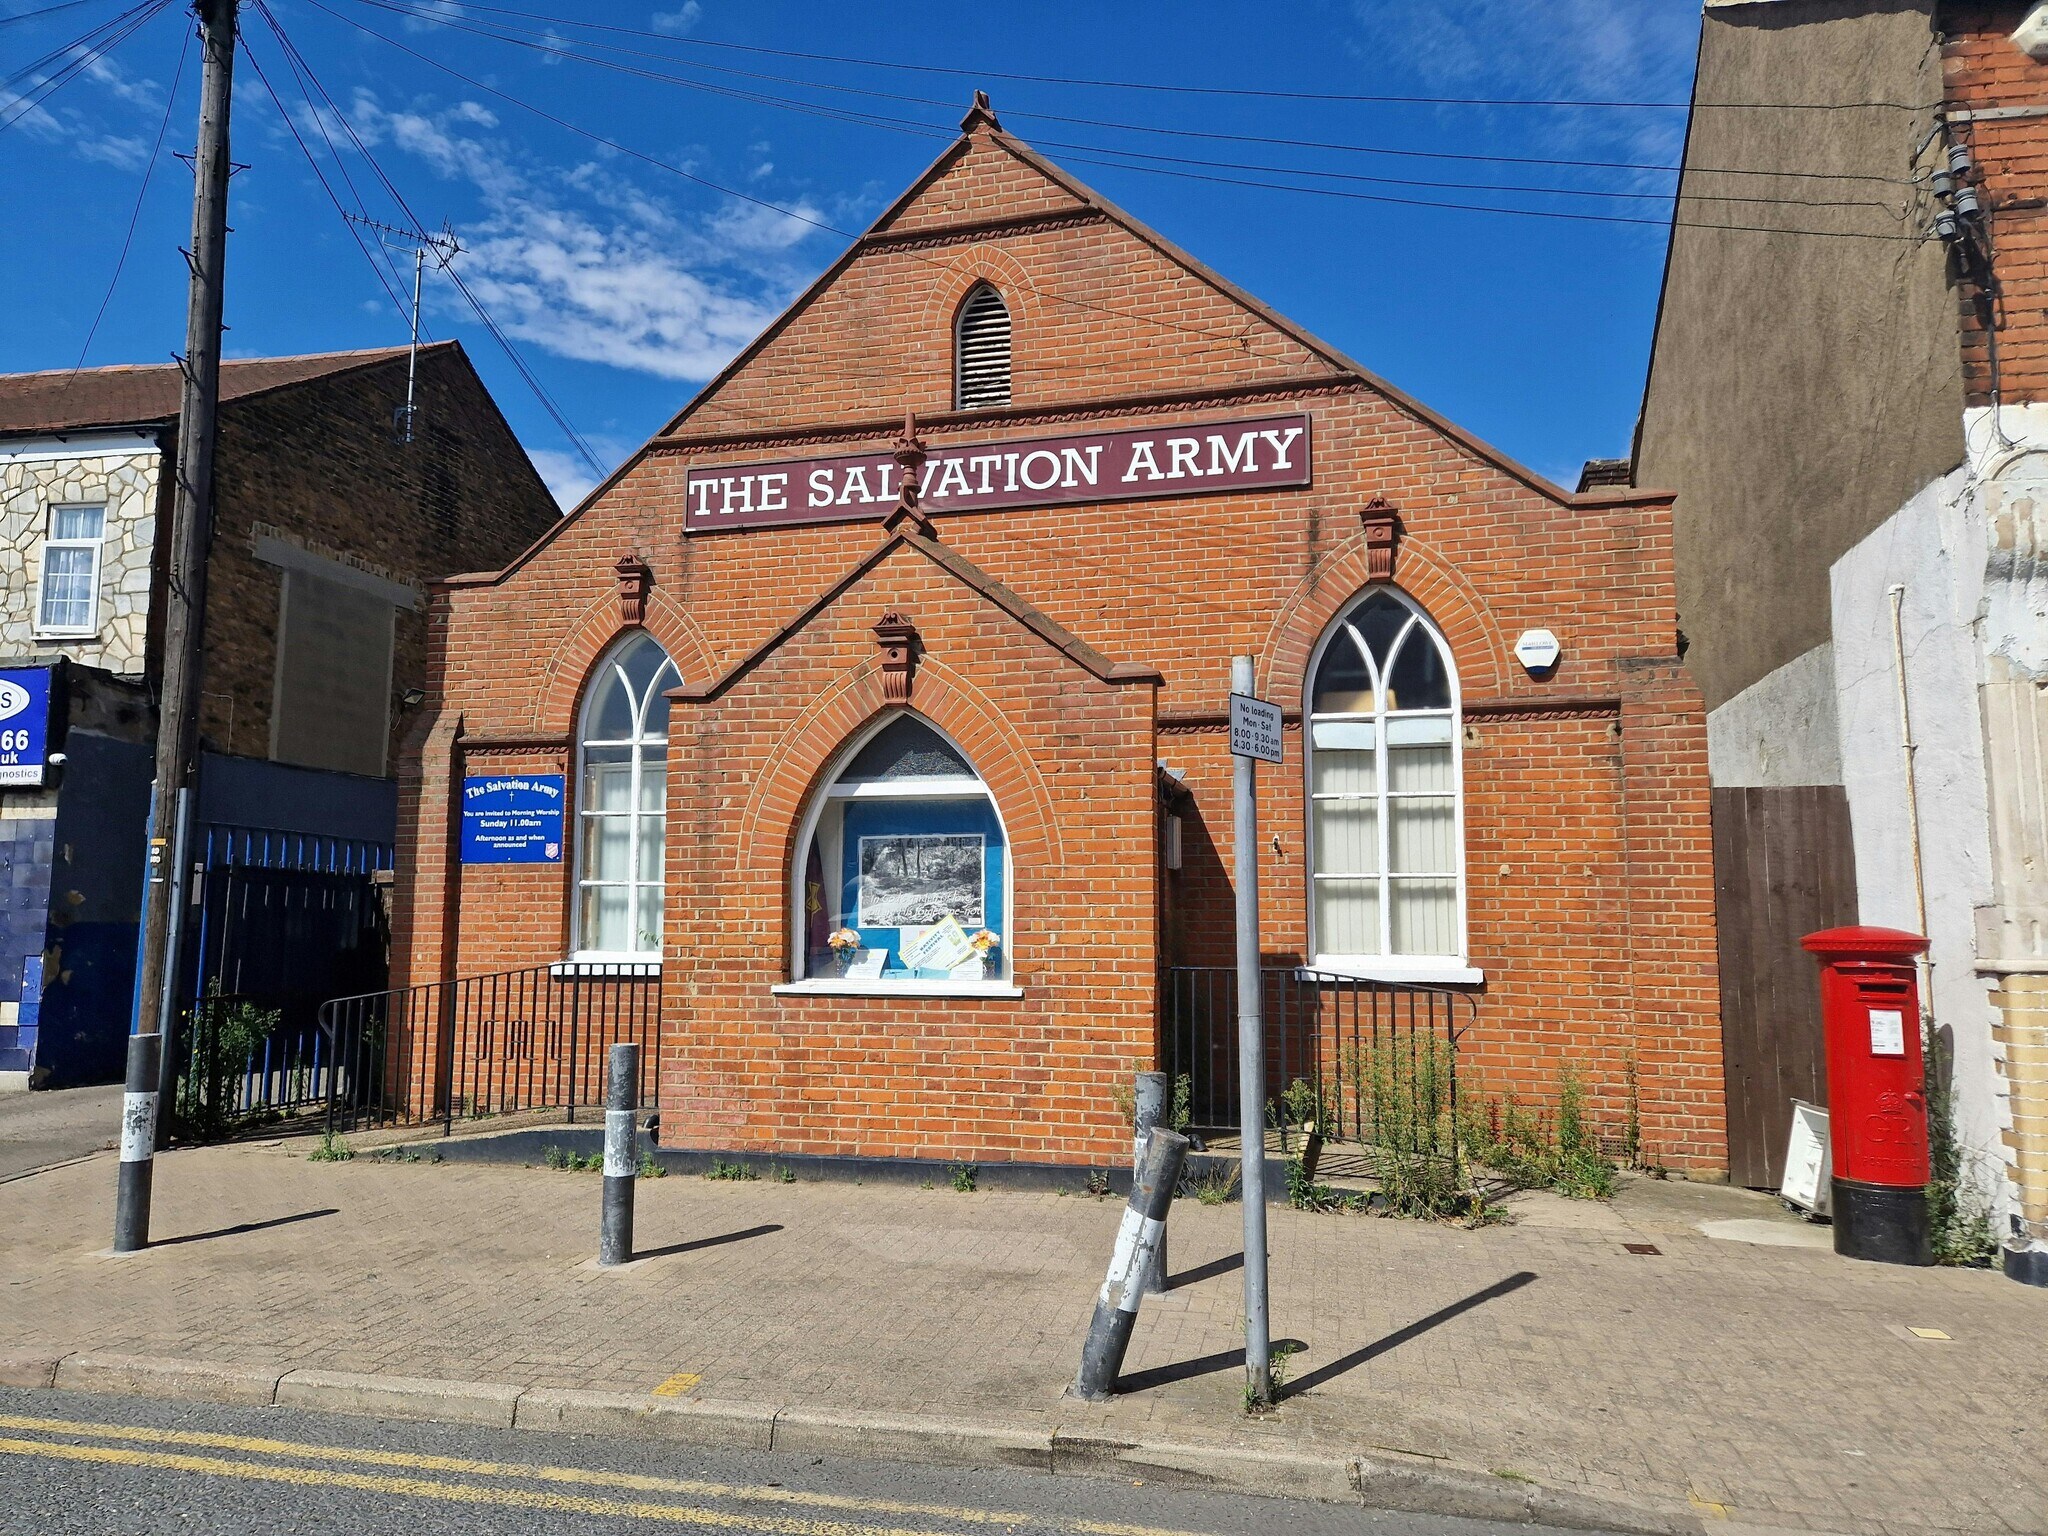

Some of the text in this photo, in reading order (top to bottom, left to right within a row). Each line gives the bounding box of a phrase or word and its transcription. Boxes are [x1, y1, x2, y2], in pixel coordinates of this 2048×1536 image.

[689, 427, 1303, 516] THE SALVATION ARMY
[1240, 703, 1274, 721] No loading
[1, 729, 29, 751] 66
[0, 769, 39, 780] nostics
[465, 780, 559, 799] The Salvation Army
[480, 819, 542, 829] Sunday 11.00am
